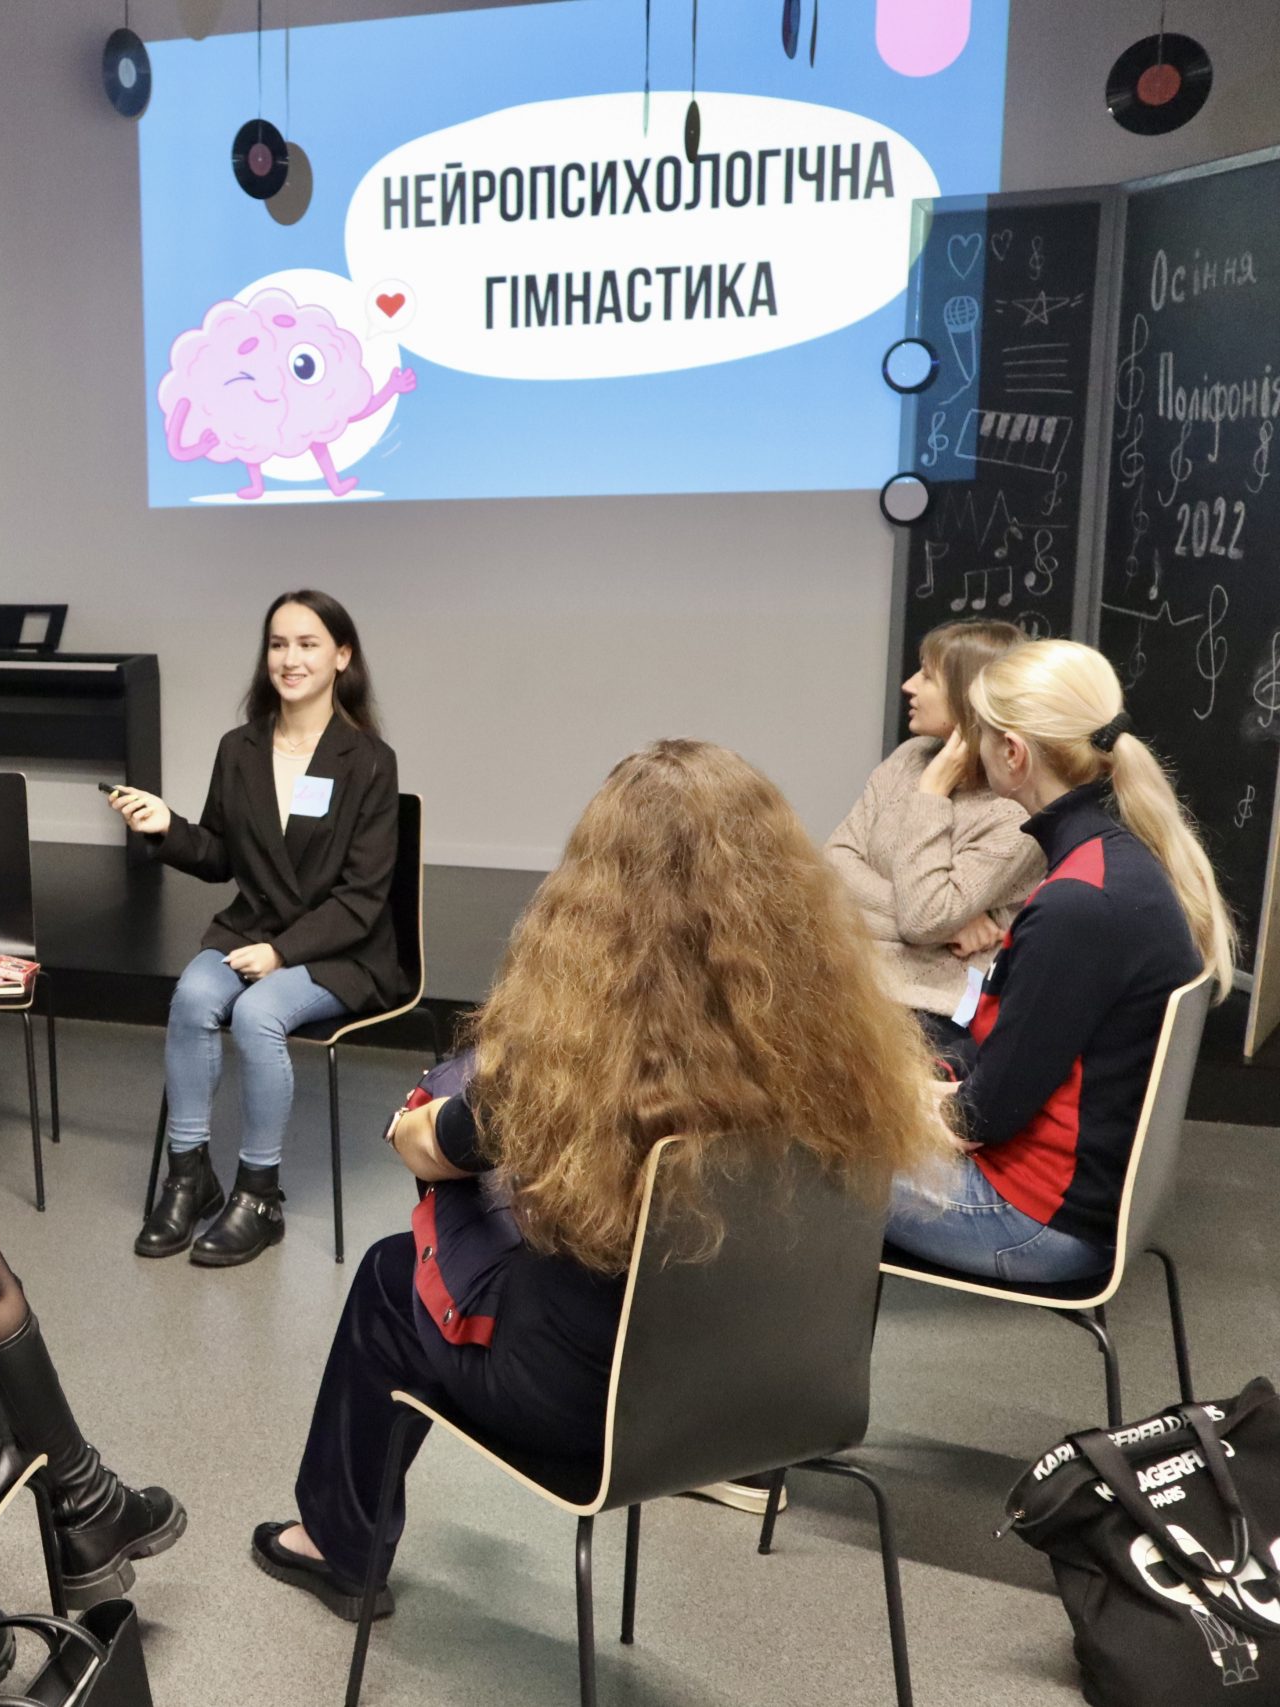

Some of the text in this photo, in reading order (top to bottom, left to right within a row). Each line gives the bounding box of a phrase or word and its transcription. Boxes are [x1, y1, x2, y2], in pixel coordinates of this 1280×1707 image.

[382, 140, 896, 231] НЕЙРОПСИХОЛОГІЧНА
[484, 260, 779, 330] ГІМНАСТИКА
[1151, 248, 1257, 312] Осіння
[1175, 496, 1245, 560] 2022
[1148, 1485, 1186, 1509] PARIS
